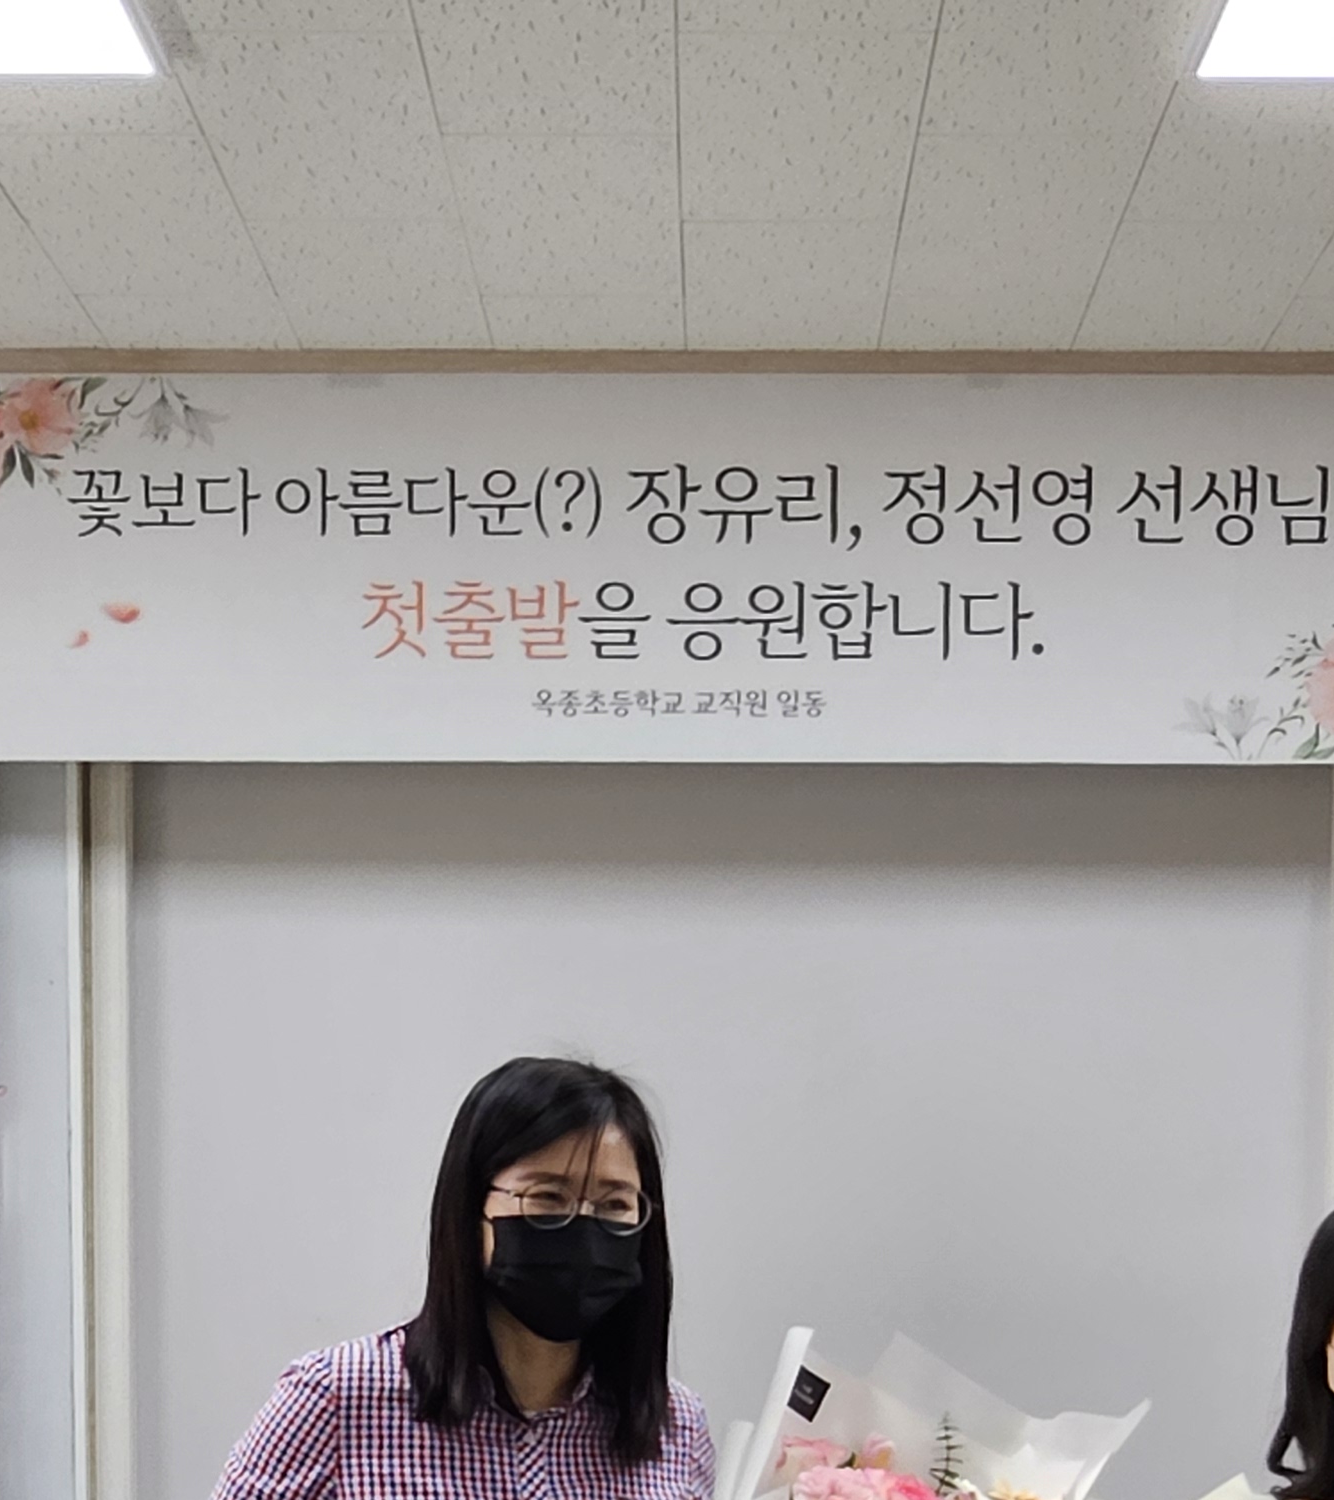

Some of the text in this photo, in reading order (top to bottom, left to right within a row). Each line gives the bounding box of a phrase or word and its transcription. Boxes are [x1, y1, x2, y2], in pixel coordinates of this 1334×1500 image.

[67, 467, 261, 538] 꽃보다
[275, 466, 602, 538] 아름다운(?)
[625, 462, 862, 551] 장유리,
[882, 462, 1094, 546] 정선영
[362, 580, 1045, 661] 첫출발을 응원합니다.
[531, 688, 827, 718] 옥종초등학교 교직원 일동
